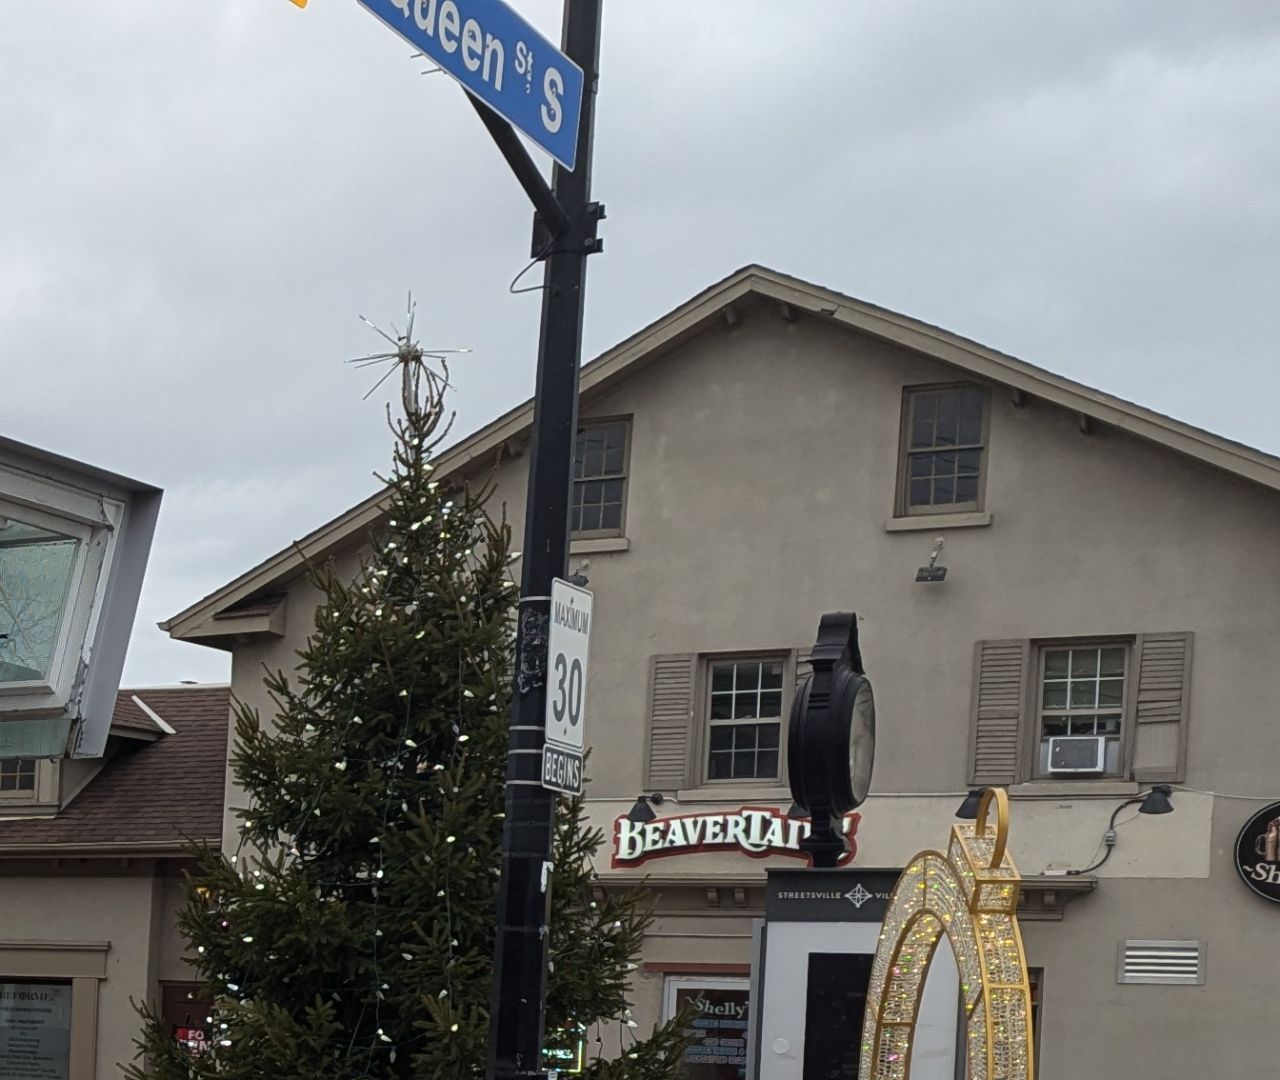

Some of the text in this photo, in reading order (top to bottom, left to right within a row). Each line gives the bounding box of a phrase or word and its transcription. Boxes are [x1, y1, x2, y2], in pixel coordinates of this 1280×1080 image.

[391, 0, 505, 92] ueen
[541, 67, 564, 133] S
[554, 601, 589, 635] MAXIMUM
[552, 652, 583, 727] 30
[545, 752, 580, 788] BEGINS
[777, 891, 842, 899] STREETSVILLE
[188, 1029, 205, 1040] FO
